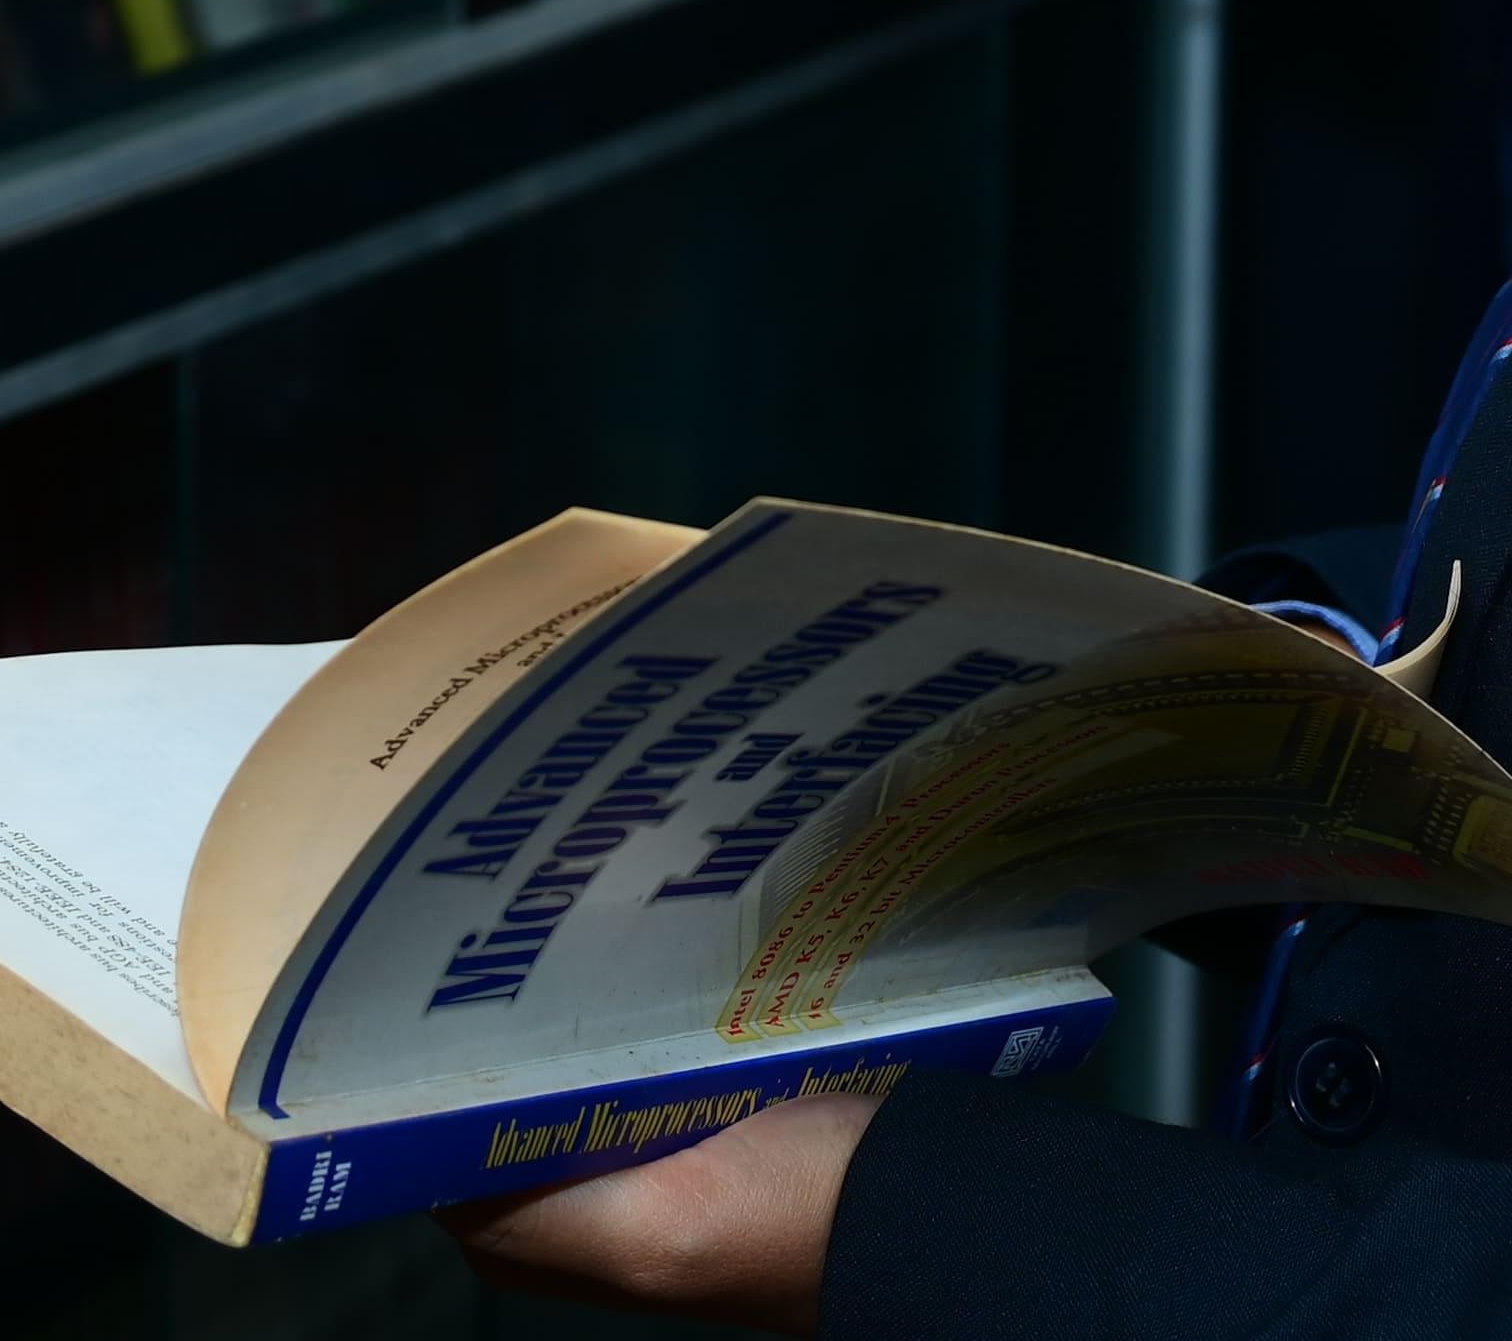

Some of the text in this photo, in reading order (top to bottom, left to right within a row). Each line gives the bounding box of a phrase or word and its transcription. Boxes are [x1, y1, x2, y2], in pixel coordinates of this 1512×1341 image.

[370, 677, 473, 770] Advanced
[424, 653, 723, 882] Advanced
[645, 647, 1059, 907] Interfacing
[714, 731, 805, 783] and
[424, 579, 948, 1015] Microprocessors
[8, 831, 84, 878] gratefully
[766, 971, 801, 1028] AMD
[859, 856, 890, 891] K7
[895, 825, 933, 853] and
[928, 779, 999, 821] Duron
[995, 725, 1110, 777] Processors
[81, 881, 102, 894] be
[88, 902, 114, 917] for
[99, 895, 132, 915] will
[728, 987, 756, 1037] Intel
[752, 925, 794, 982] 8086
[792, 900, 814, 920] to
[900, 741, 1011, 808] Processors
[809, 777, 1057, 1020] 16 and 32 bit Microcontrollers
[70, 923, 99, 943] bus
[76, 913, 111, 933] and
[117, 921, 172, 961] estions
[130, 917, 166, 937] and
[90, 953, 119, 973] bus
[98, 946, 140, 969] AGP
[138, 973, 173, 993] and
[484, 1105, 587, 1169] Advanced
[580, 1085, 763, 1155] Microprocessors
[300, 1150, 332, 1222] BADRI
[324, 1160, 352, 1212] RAM
